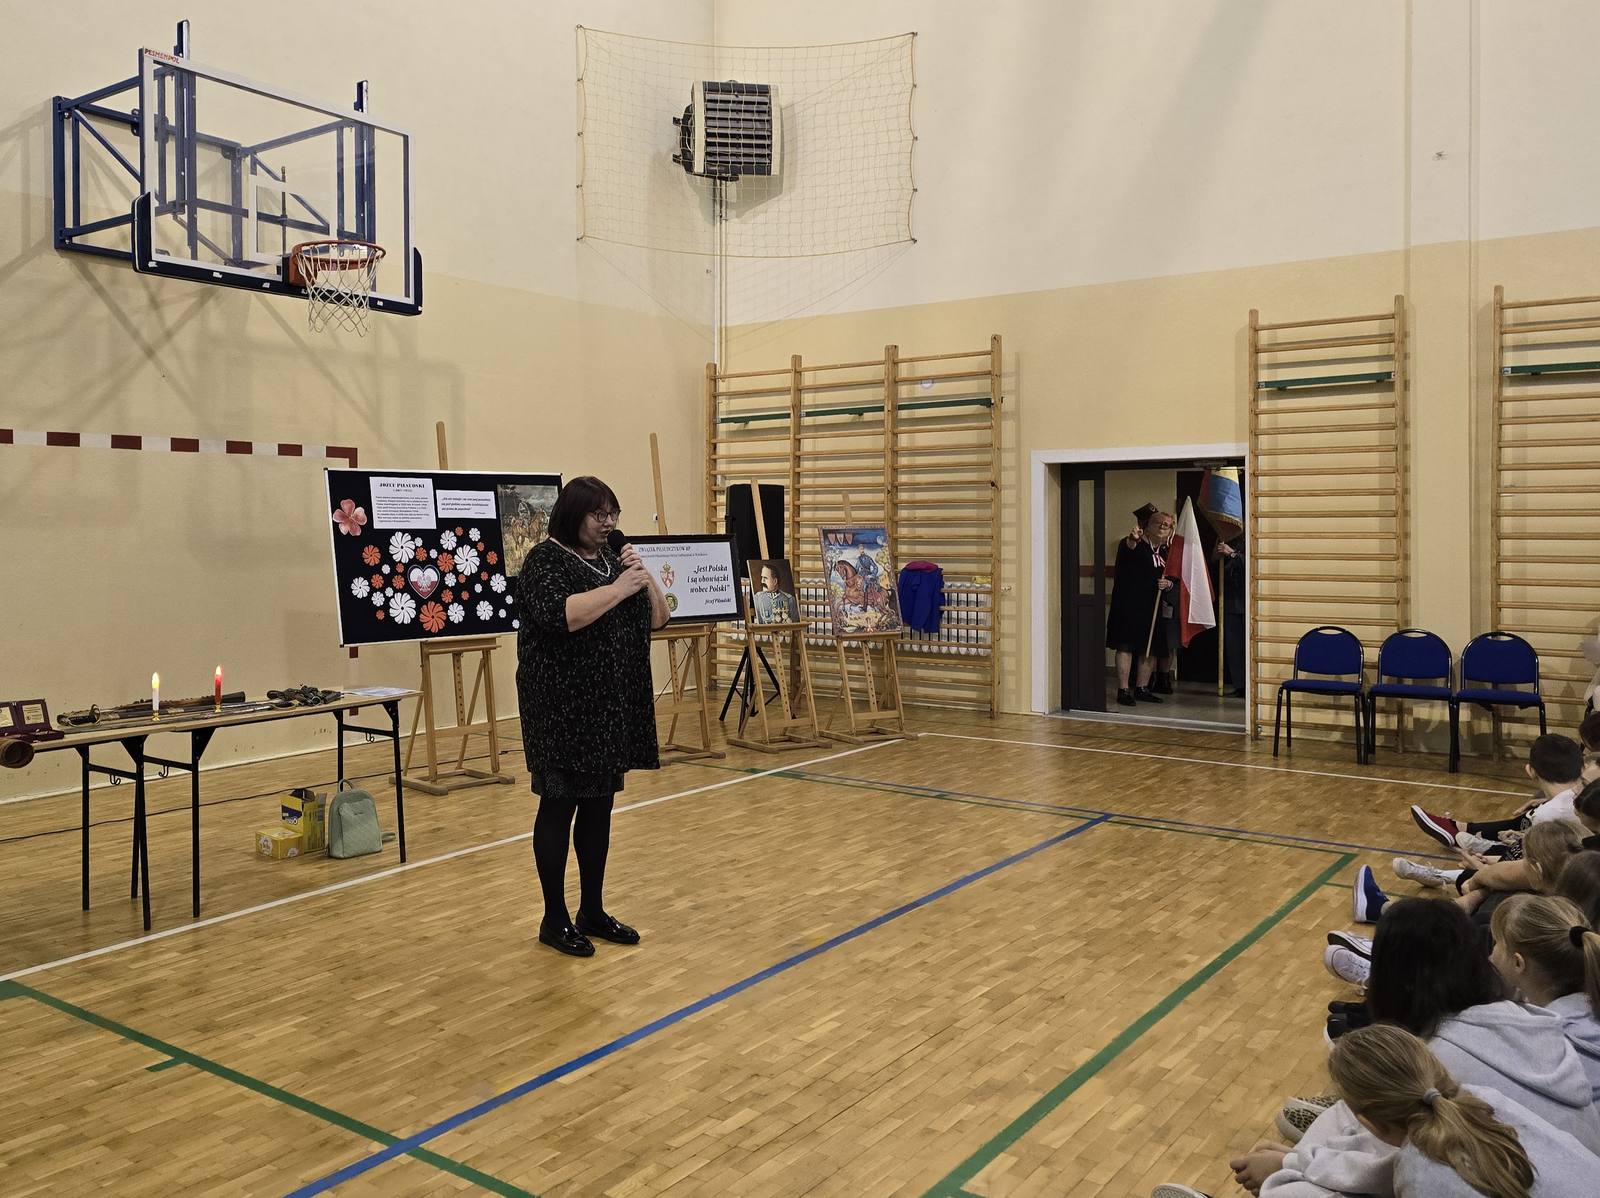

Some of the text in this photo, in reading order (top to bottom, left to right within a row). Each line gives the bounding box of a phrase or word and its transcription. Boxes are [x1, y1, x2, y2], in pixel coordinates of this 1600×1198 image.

[708, 563, 728, 572] Polska
[698, 574, 729, 583] obowiązki
[689, 585, 708, 594] wobec
